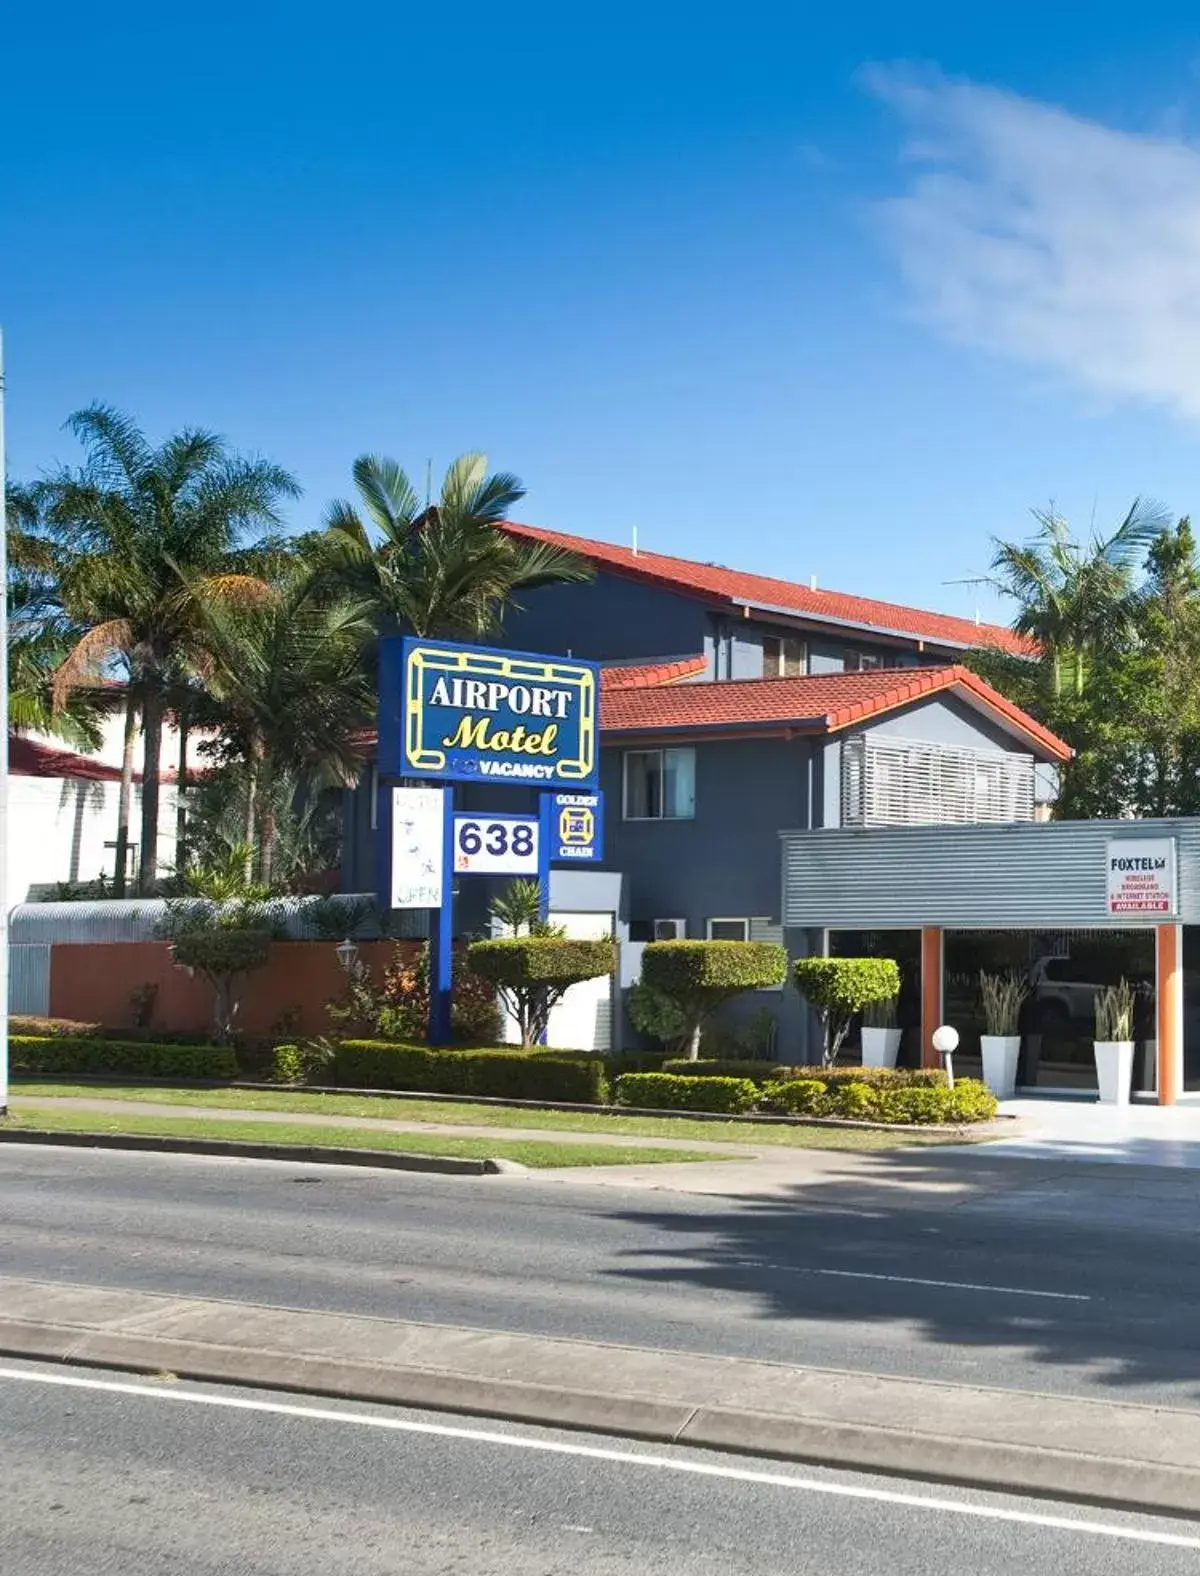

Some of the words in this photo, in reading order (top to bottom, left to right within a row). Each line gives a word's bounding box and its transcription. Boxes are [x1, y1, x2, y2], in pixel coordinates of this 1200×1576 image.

[429, 676, 573, 719] AIRPORT
[443, 715, 559, 756] Motel
[479, 760, 555, 779] VACANCY
[459, 822, 534, 857] 638
[1111, 857, 1154, 871] FOXTEL
[1116, 901, 1165, 910] AVAILABLE
